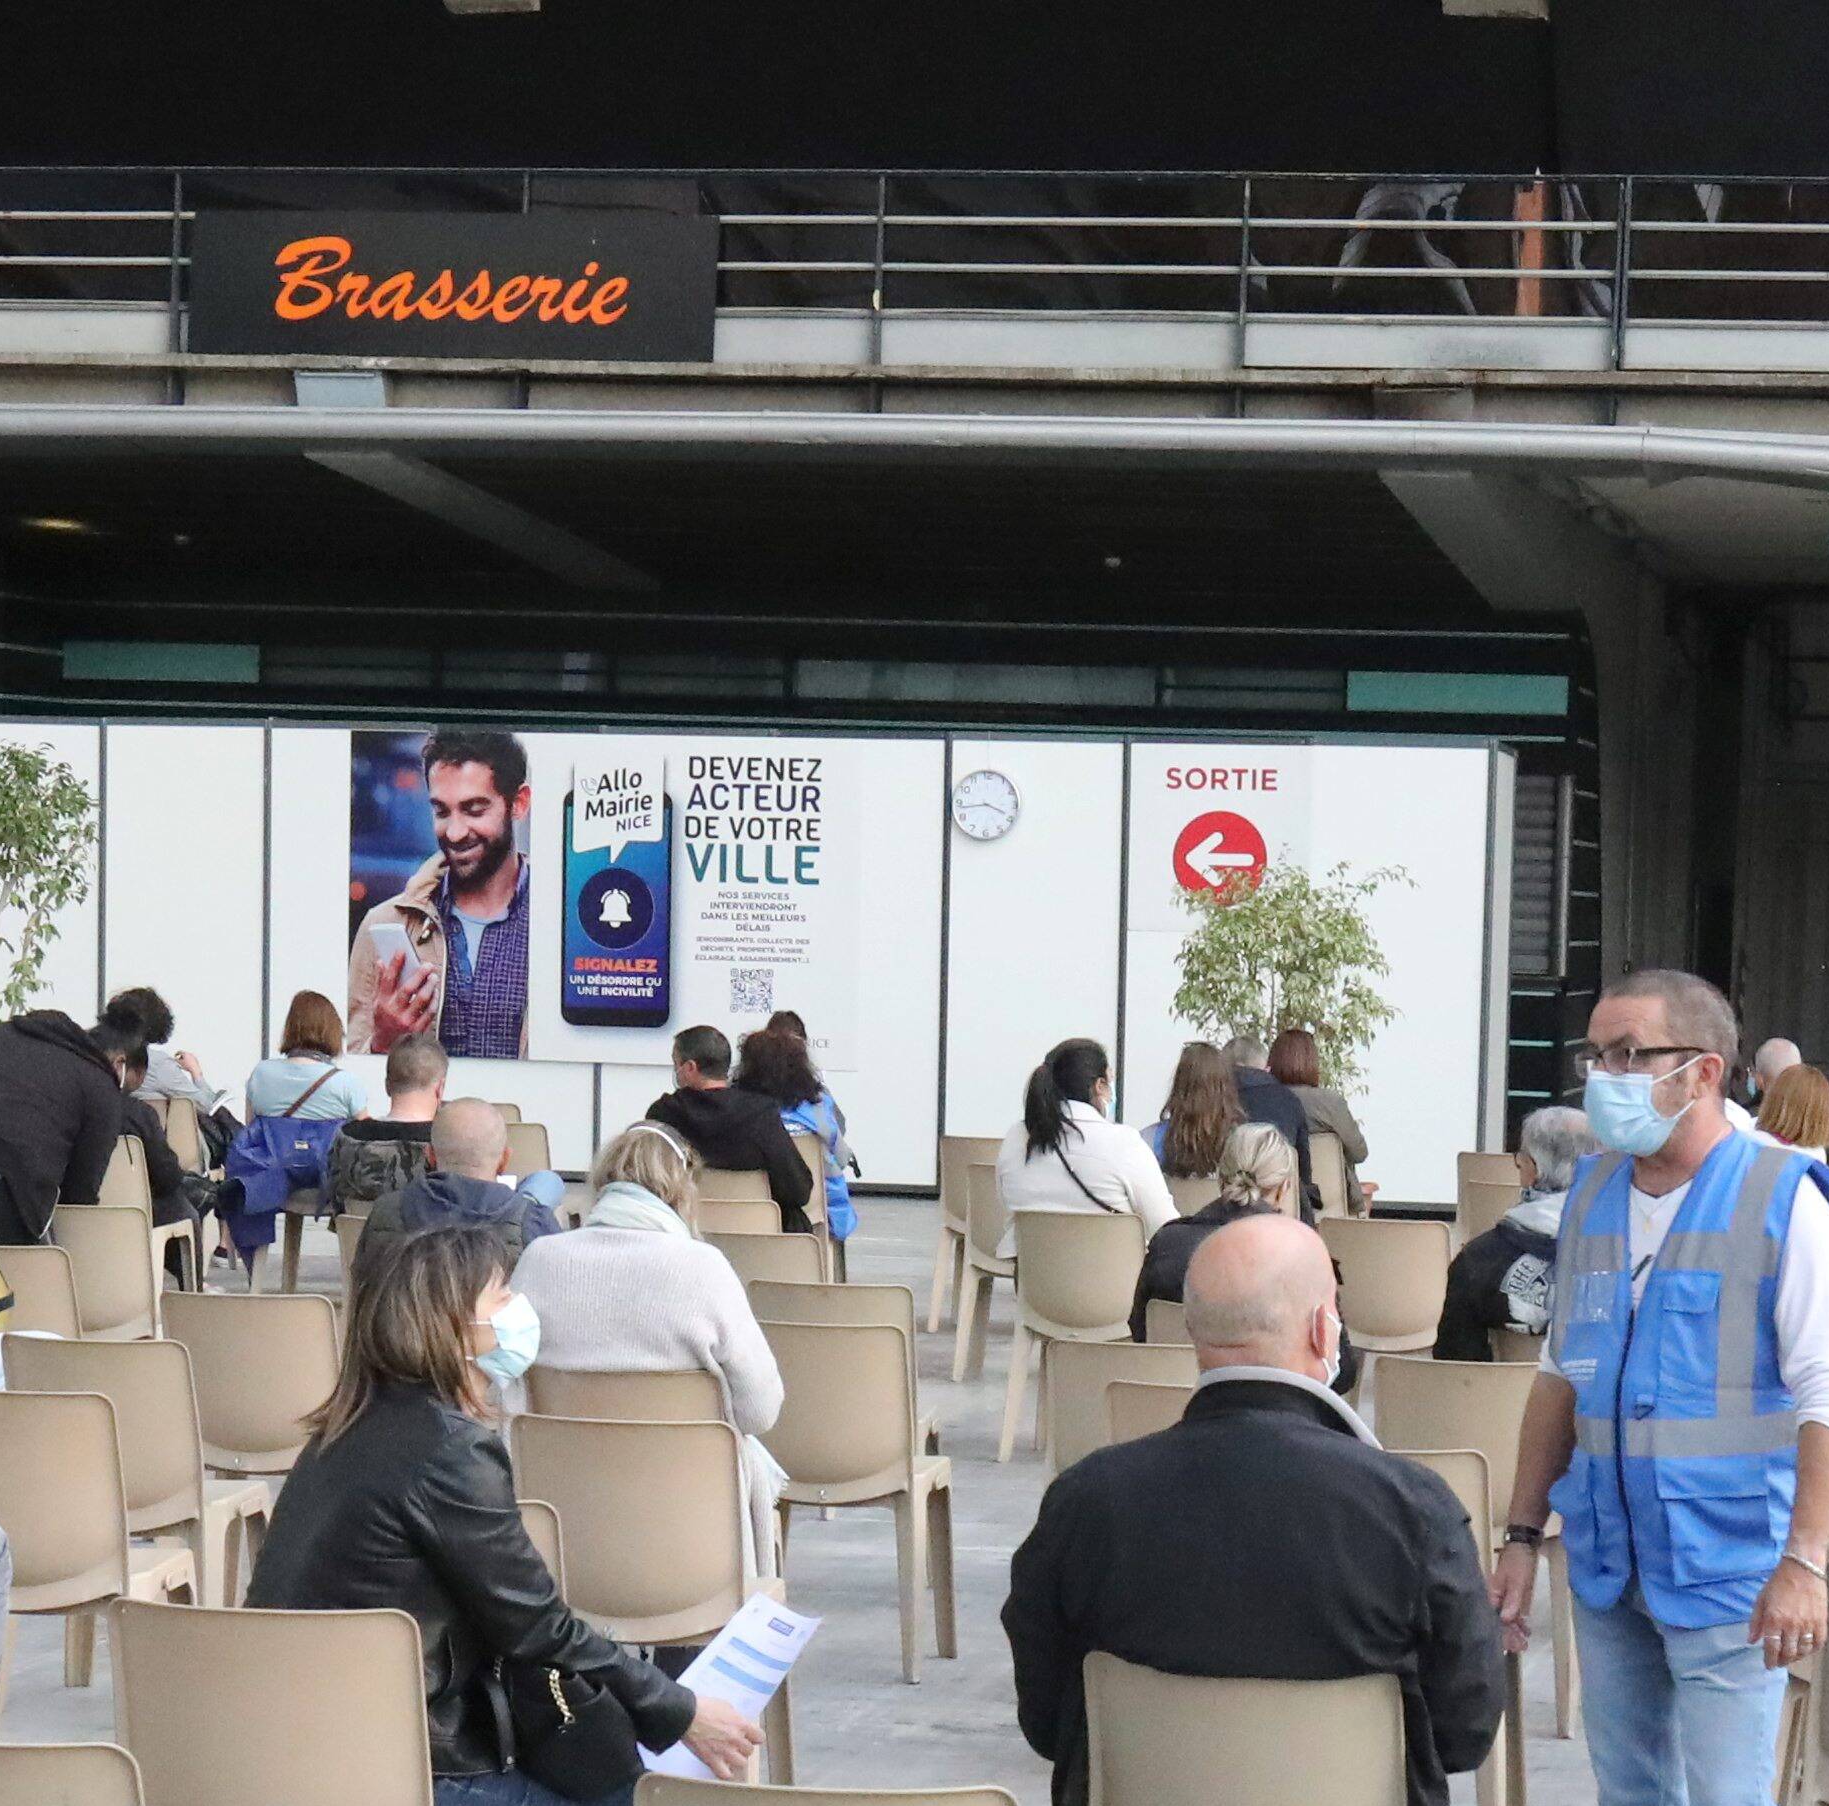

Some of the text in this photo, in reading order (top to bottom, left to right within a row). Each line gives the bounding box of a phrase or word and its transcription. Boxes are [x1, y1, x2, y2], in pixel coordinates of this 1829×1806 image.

[275, 236, 629, 325] Brasserie
[689, 756, 822, 782] DEVENEZ
[1166, 767, 1278, 791] SORTIE
[597, 768, 642, 795] Allo
[585, 791, 653, 821] Mairie
[687, 783, 821, 813] ACTEUR
[616, 814, 652, 832] NICE
[684, 816, 821, 842] DE VOTRE
[685, 843, 821, 885] VILLE
[710, 902, 798, 911] INTERVIENDRONT
[718, 891, 790, 901] NOS SERVICES
[701, 912, 806, 922] DANS LES MEILLEURS
[574, 957, 658, 973] SIGNALEZ
[569, 974, 662, 987] UN DÉSORDRE OU
[577, 986, 599, 996] UNE
